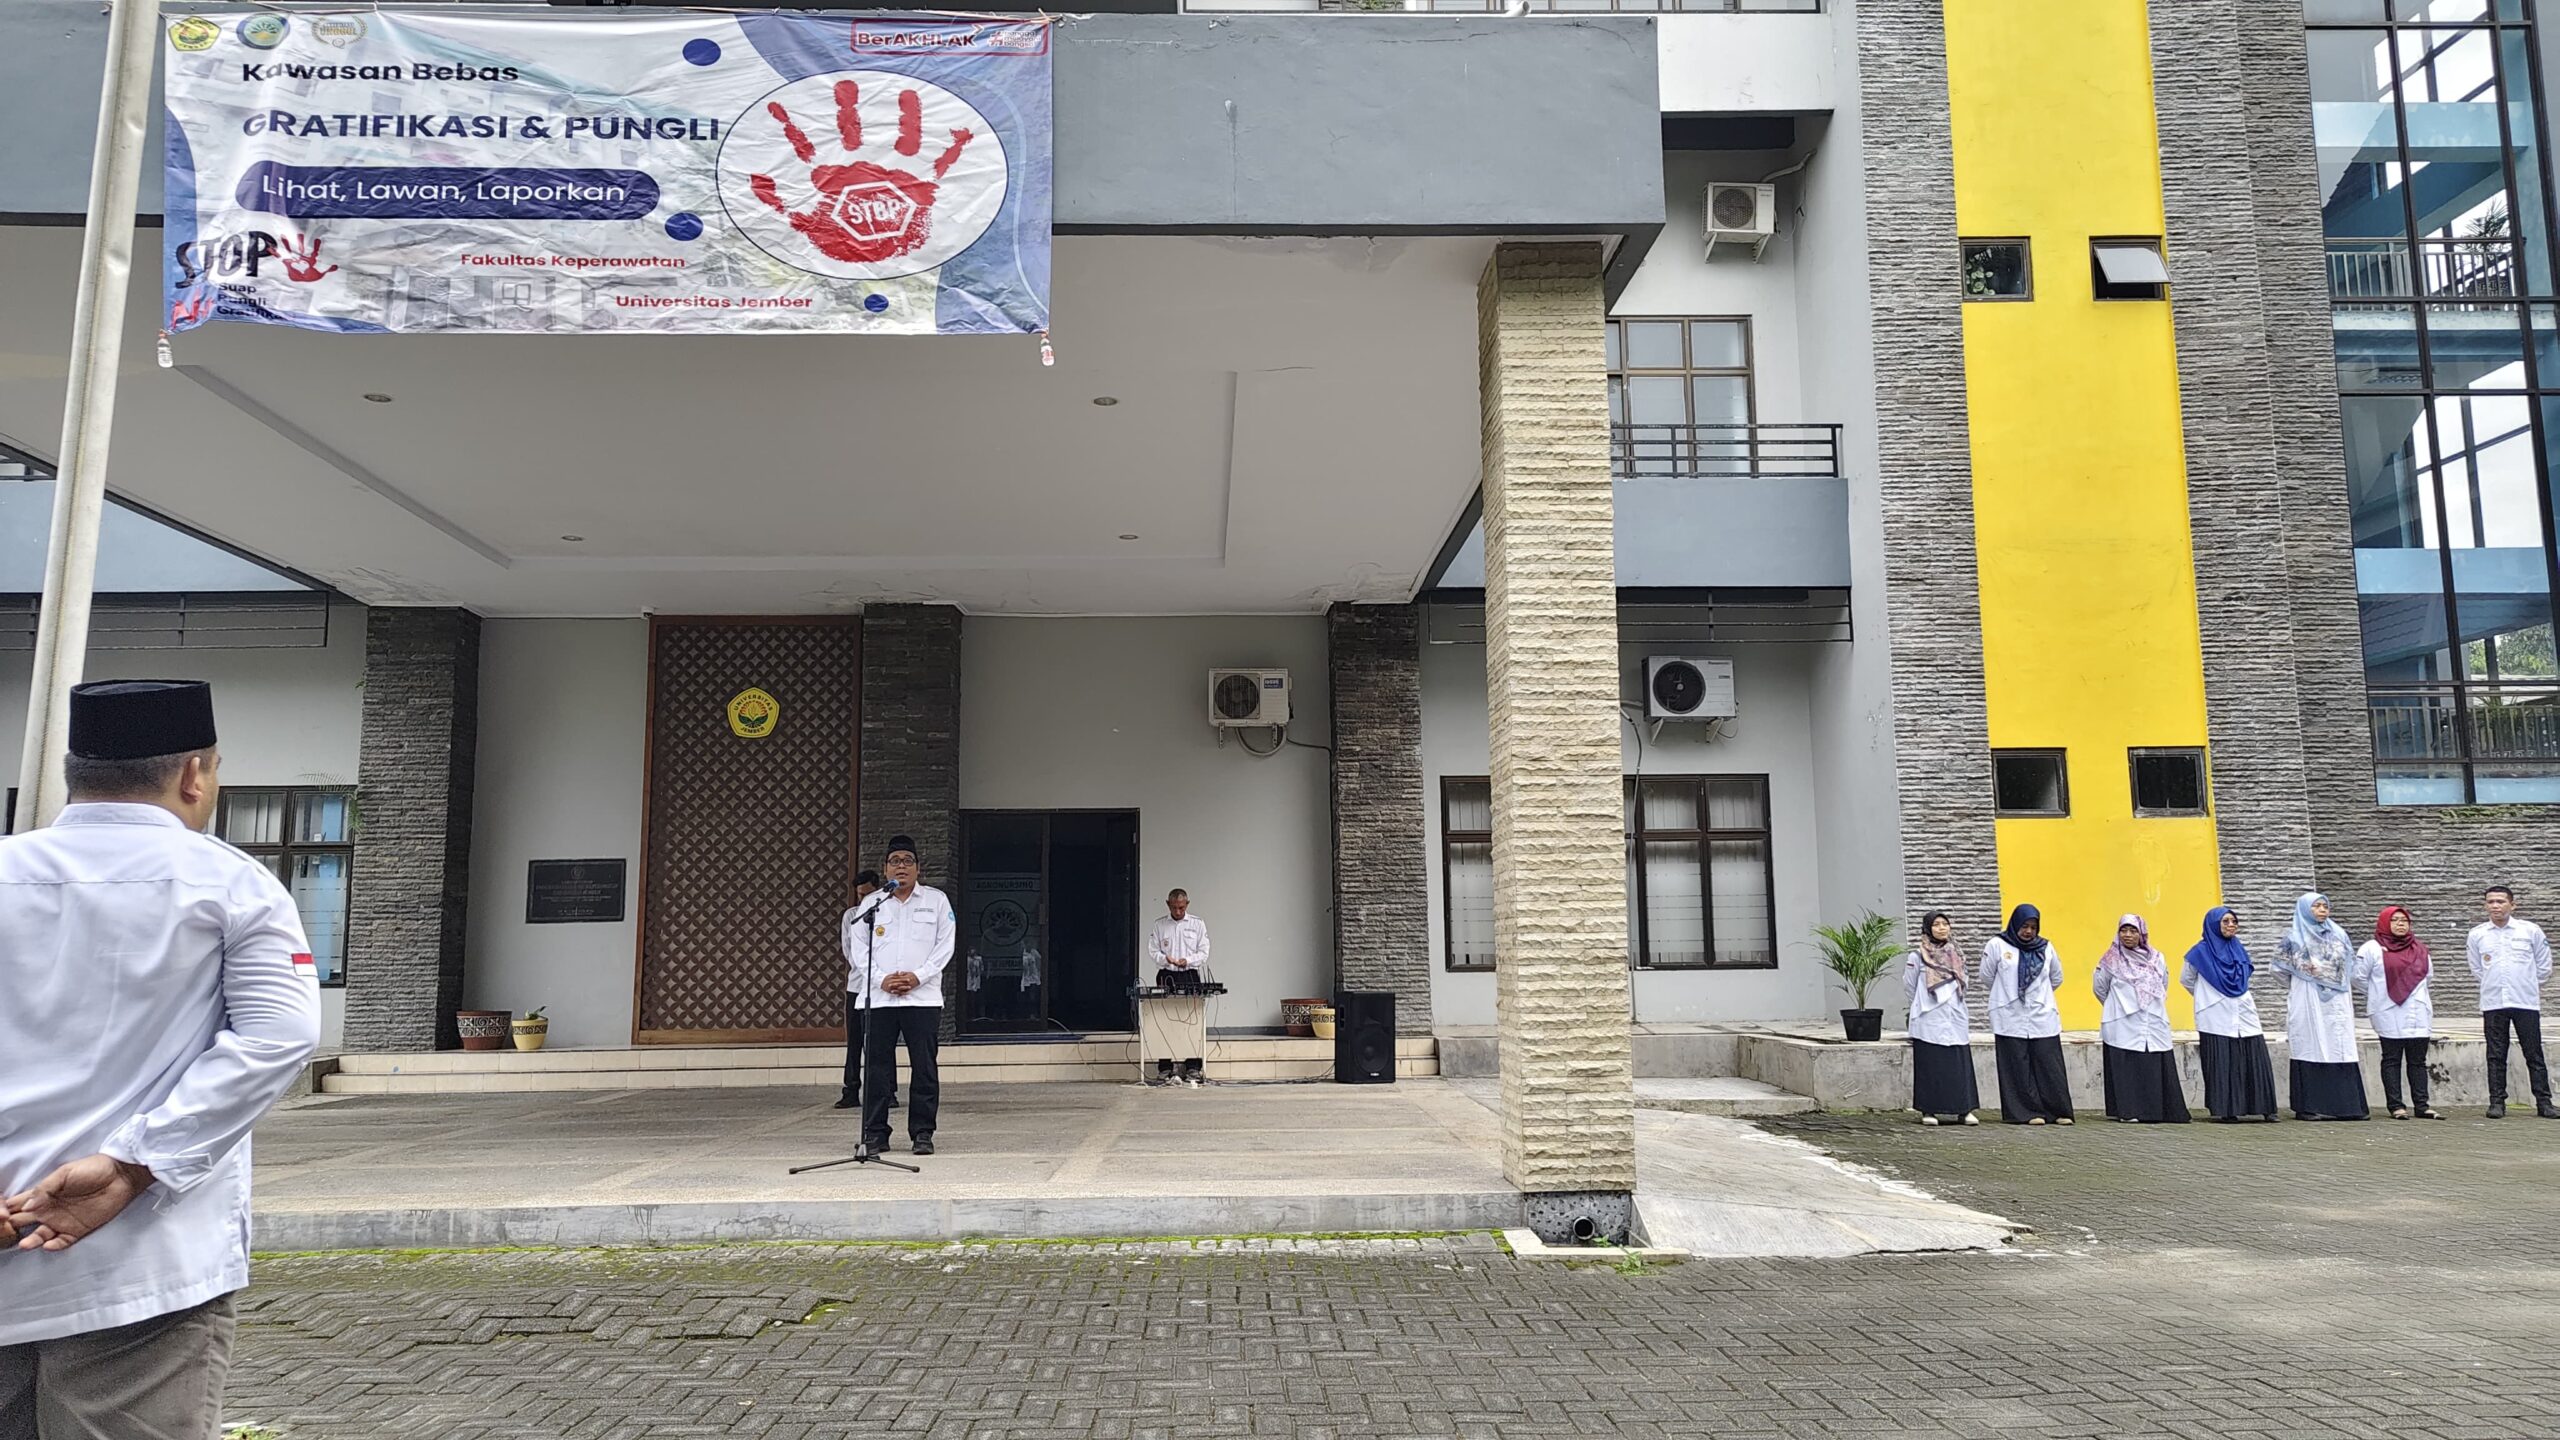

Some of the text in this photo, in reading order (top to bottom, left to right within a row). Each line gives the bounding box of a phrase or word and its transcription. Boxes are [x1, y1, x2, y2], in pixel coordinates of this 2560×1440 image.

[858, 32, 976, 47] BerAKHLAK
[242, 62, 519, 82] Kawasan Bebas
[242, 109, 719, 141] GRATIFIKASI & PUNGLI
[262, 174, 625, 206] Lihat, Lawan, Laporkan
[175, 230, 278, 289] STOP
[461, 253, 686, 270] Fakultas Keperawatan
[218, 283, 257, 295] Suap
[616, 294, 814, 309] Universitas Jember
[733, 693, 774, 711] UNIVERSITAS
